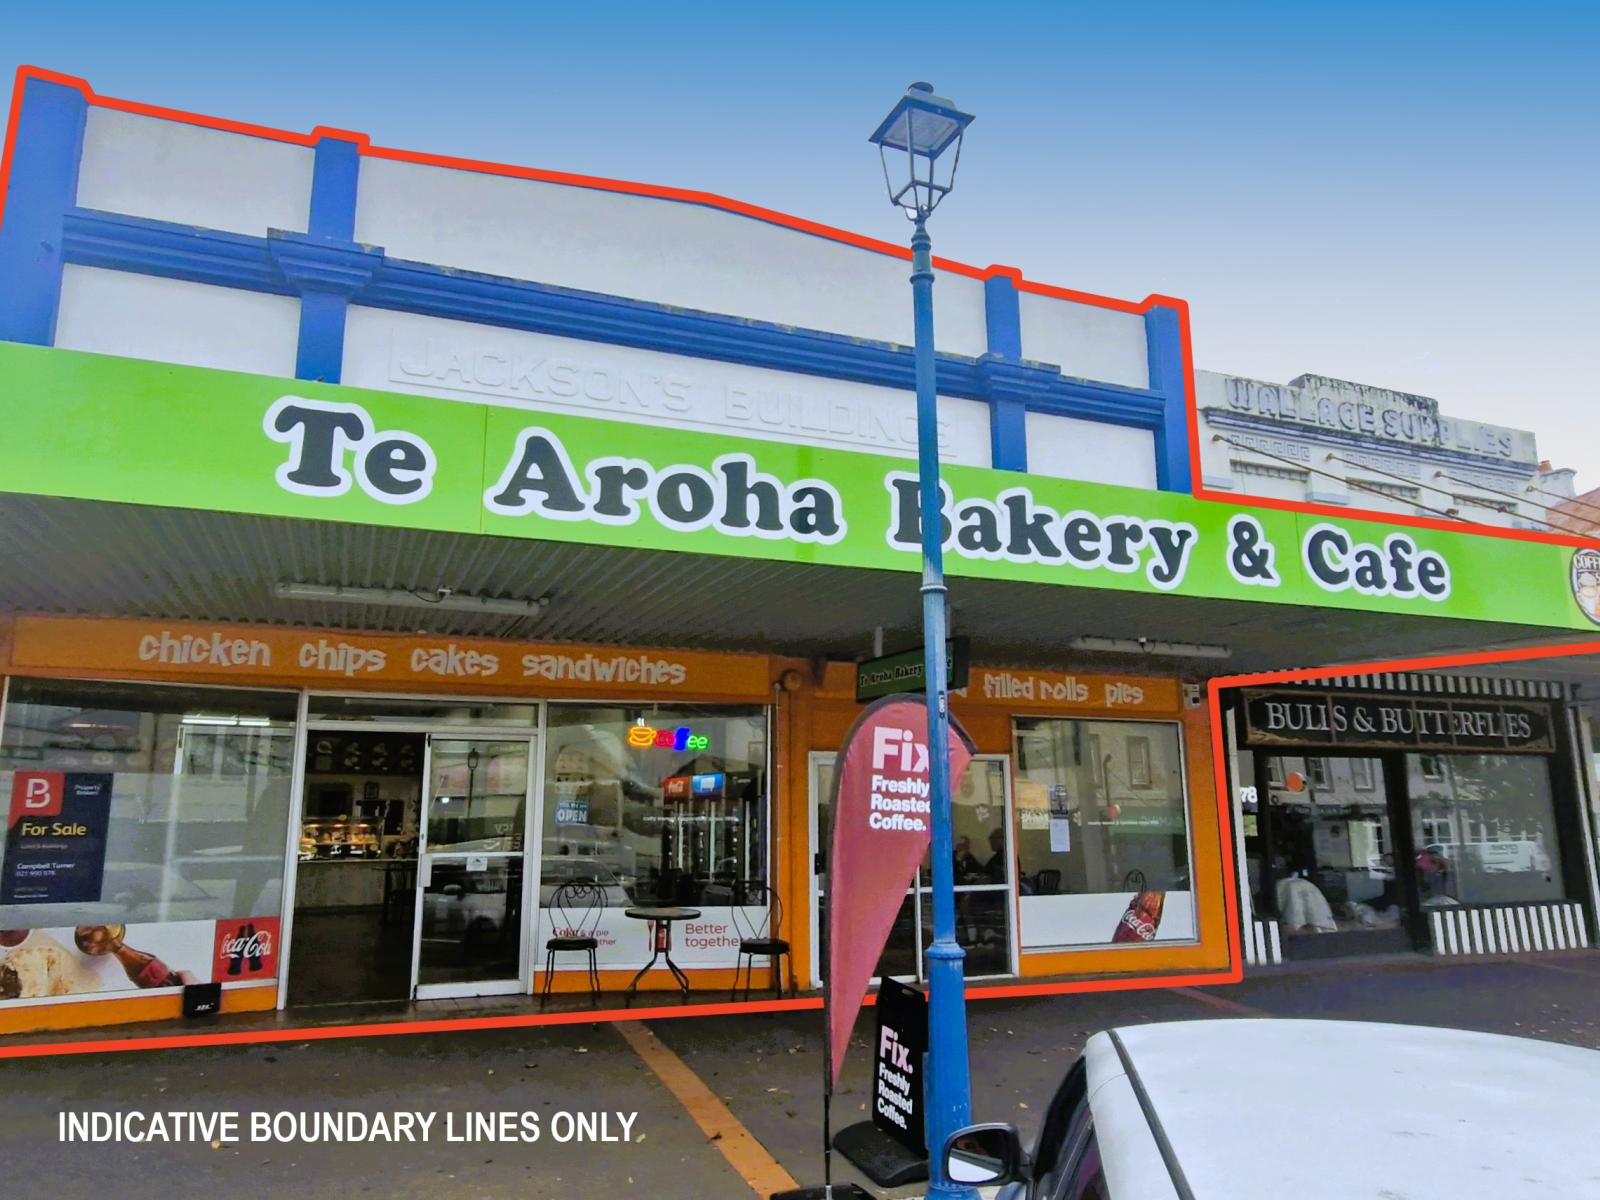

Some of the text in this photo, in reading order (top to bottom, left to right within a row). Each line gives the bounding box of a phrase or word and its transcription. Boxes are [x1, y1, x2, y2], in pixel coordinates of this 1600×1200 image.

[399, 338, 694, 412] JACKSON'S
[1226, 377, 1513, 458] WALLACE SUPPLIES
[272, 402, 1448, 597] Te Aroha Bakery & Cafe
[138, 631, 688, 685] chicken chips cakes sandwiches
[895, 663, 924, 679] Bakery
[984, 672, 1034, 700] filled
[1039, 675, 1089, 702] rolls
[1104, 681, 1144, 708] pies
[1353, 706, 1377, 732] &
[1378, 707, 1532, 738] BUTTERFLIES
[25, 778, 51, 808] B
[871, 774, 931, 798] Freshly
[22, 822, 87, 836] For Sale
[556, 810, 588, 823] OPEN
[869, 812, 928, 831] Coffee.
[685, 936, 739, 949] togethe
[686, 923, 728, 935] Better
[879, 1024, 914, 1074] Fix.
[878, 1061, 911, 1097] Freshly
[878, 1079, 913, 1115] Roasted
[877, 1097, 908, 1130] Coffee.
